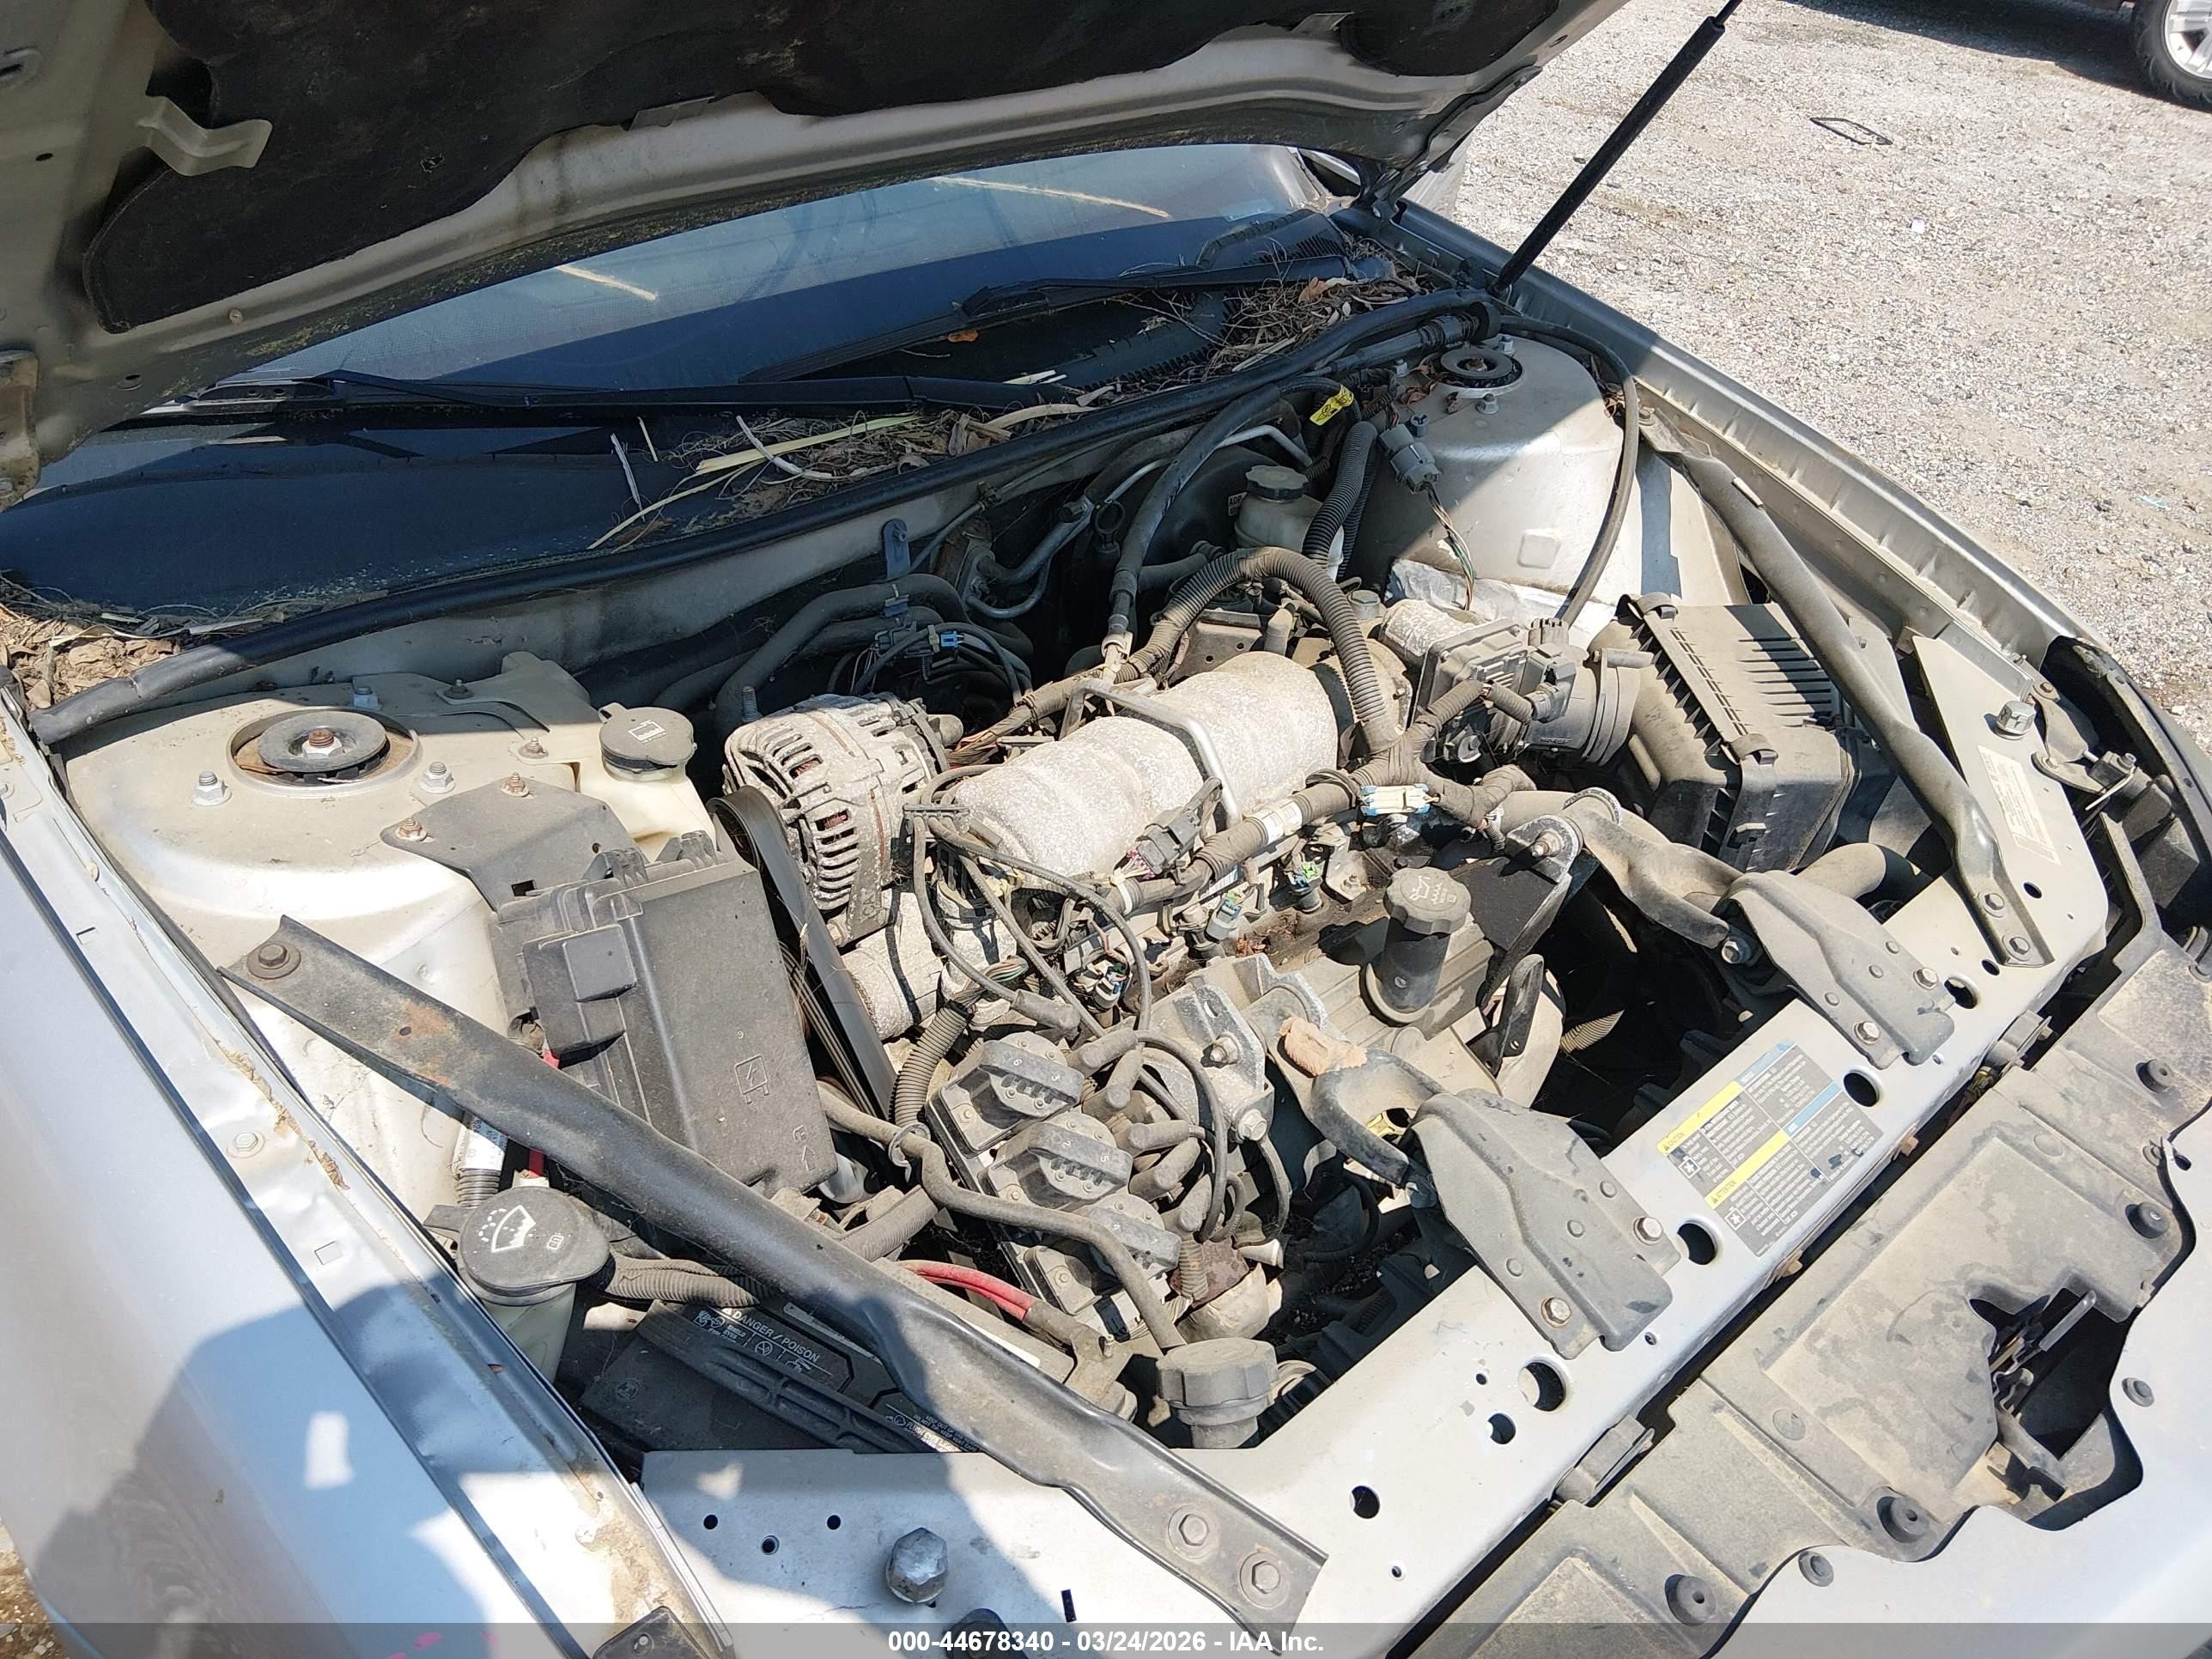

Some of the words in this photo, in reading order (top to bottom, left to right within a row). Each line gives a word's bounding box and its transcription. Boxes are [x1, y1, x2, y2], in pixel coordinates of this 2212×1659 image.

[1013, 1058, 1023, 1066] 6
[1051, 1074, 1060, 1083] 3
[1062, 1140, 1072, 1149] 2
[1101, 1154, 1109, 1163] 5
[732, 1310, 775, 1338] DANGER
[781, 1337, 821, 1363] POISON
